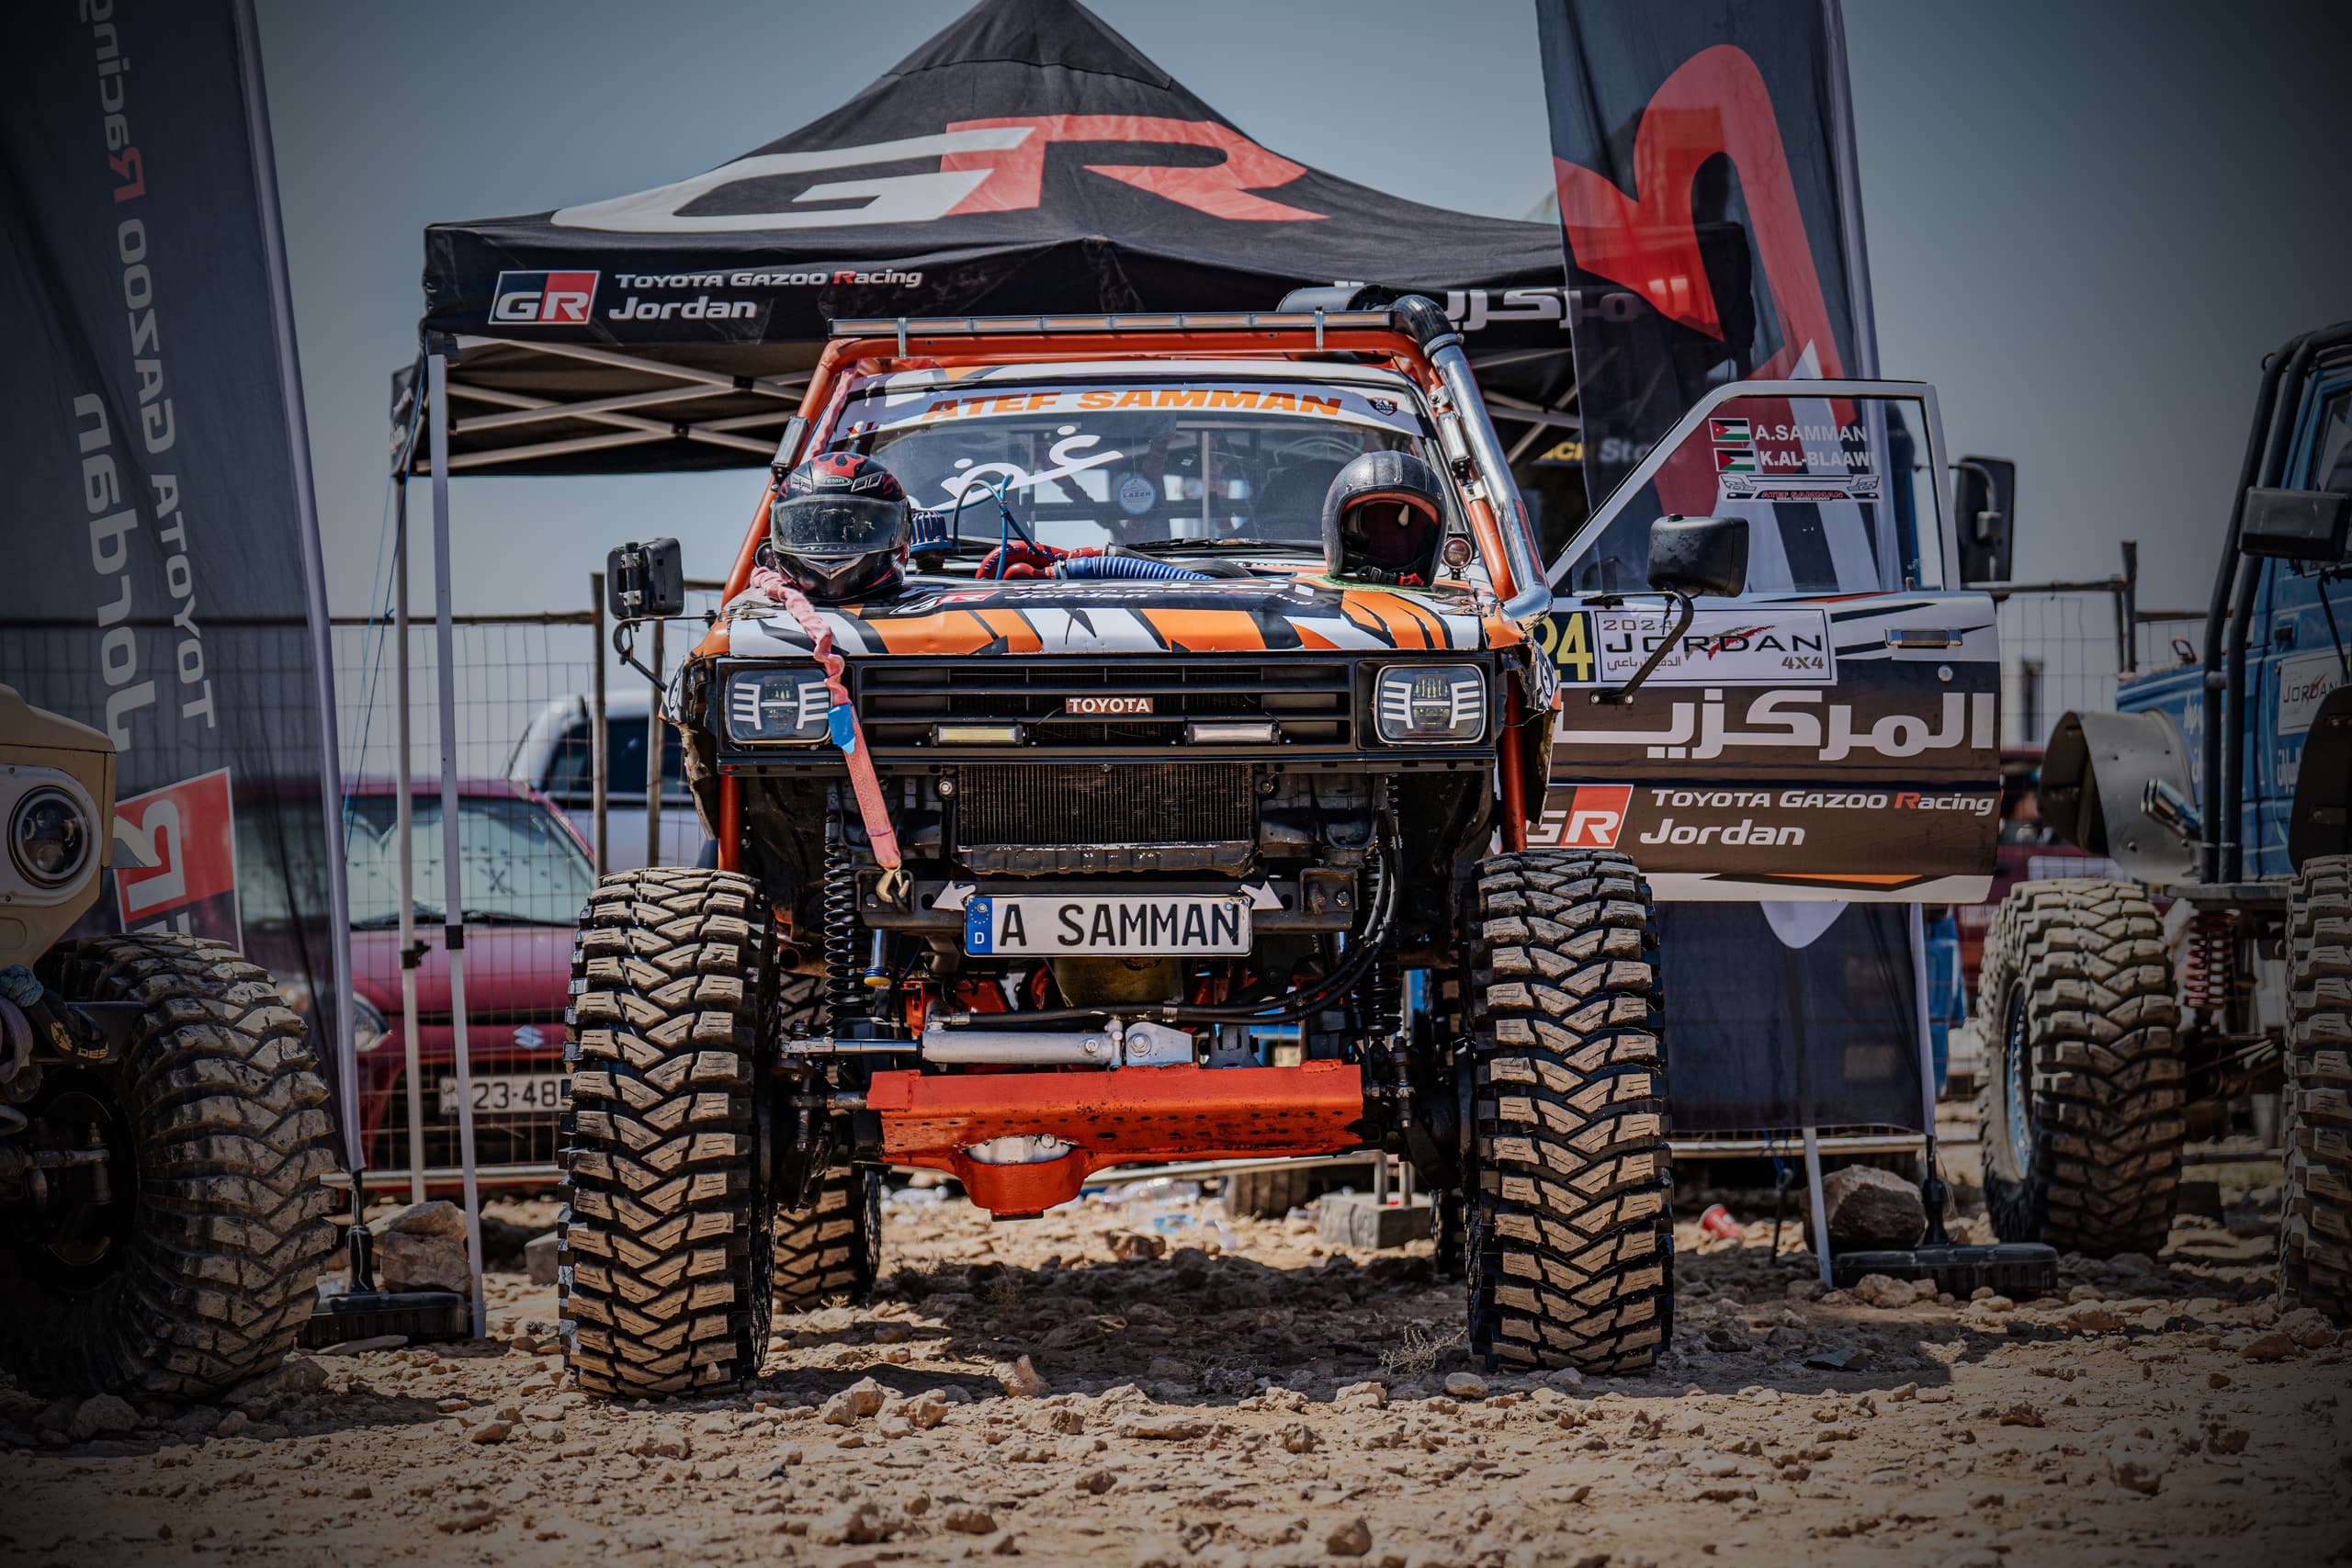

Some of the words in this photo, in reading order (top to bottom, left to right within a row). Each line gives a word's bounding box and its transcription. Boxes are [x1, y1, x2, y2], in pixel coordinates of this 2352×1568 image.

[550, 114, 1330, 232] GR
[615, 273, 723, 289] TOYOTA
[729, 270, 828, 288] GAZOO
[832, 268, 923, 290] Racing
[494, 290, 592, 321] GR
[608, 296, 758, 321] Jordan
[921, 391, 1063, 422] ATEF
[1075, 389, 1342, 416] SAMMAN
[1755, 424, 1869, 442] A.SAMMAN
[1781, 656, 1825, 670] 4X4
[1069, 697, 1150, 713] TOYOTA
[1651, 789, 1771, 809] TOYOTA
[1779, 790, 1888, 810] GAZOO
[1894, 792, 1996, 817] Racing
[1639, 818, 1806, 846] Jordan
[974, 931, 985, 945] D
[998, 903, 1028, 948] A
[1057, 903, 1240, 948] SAMMAN
